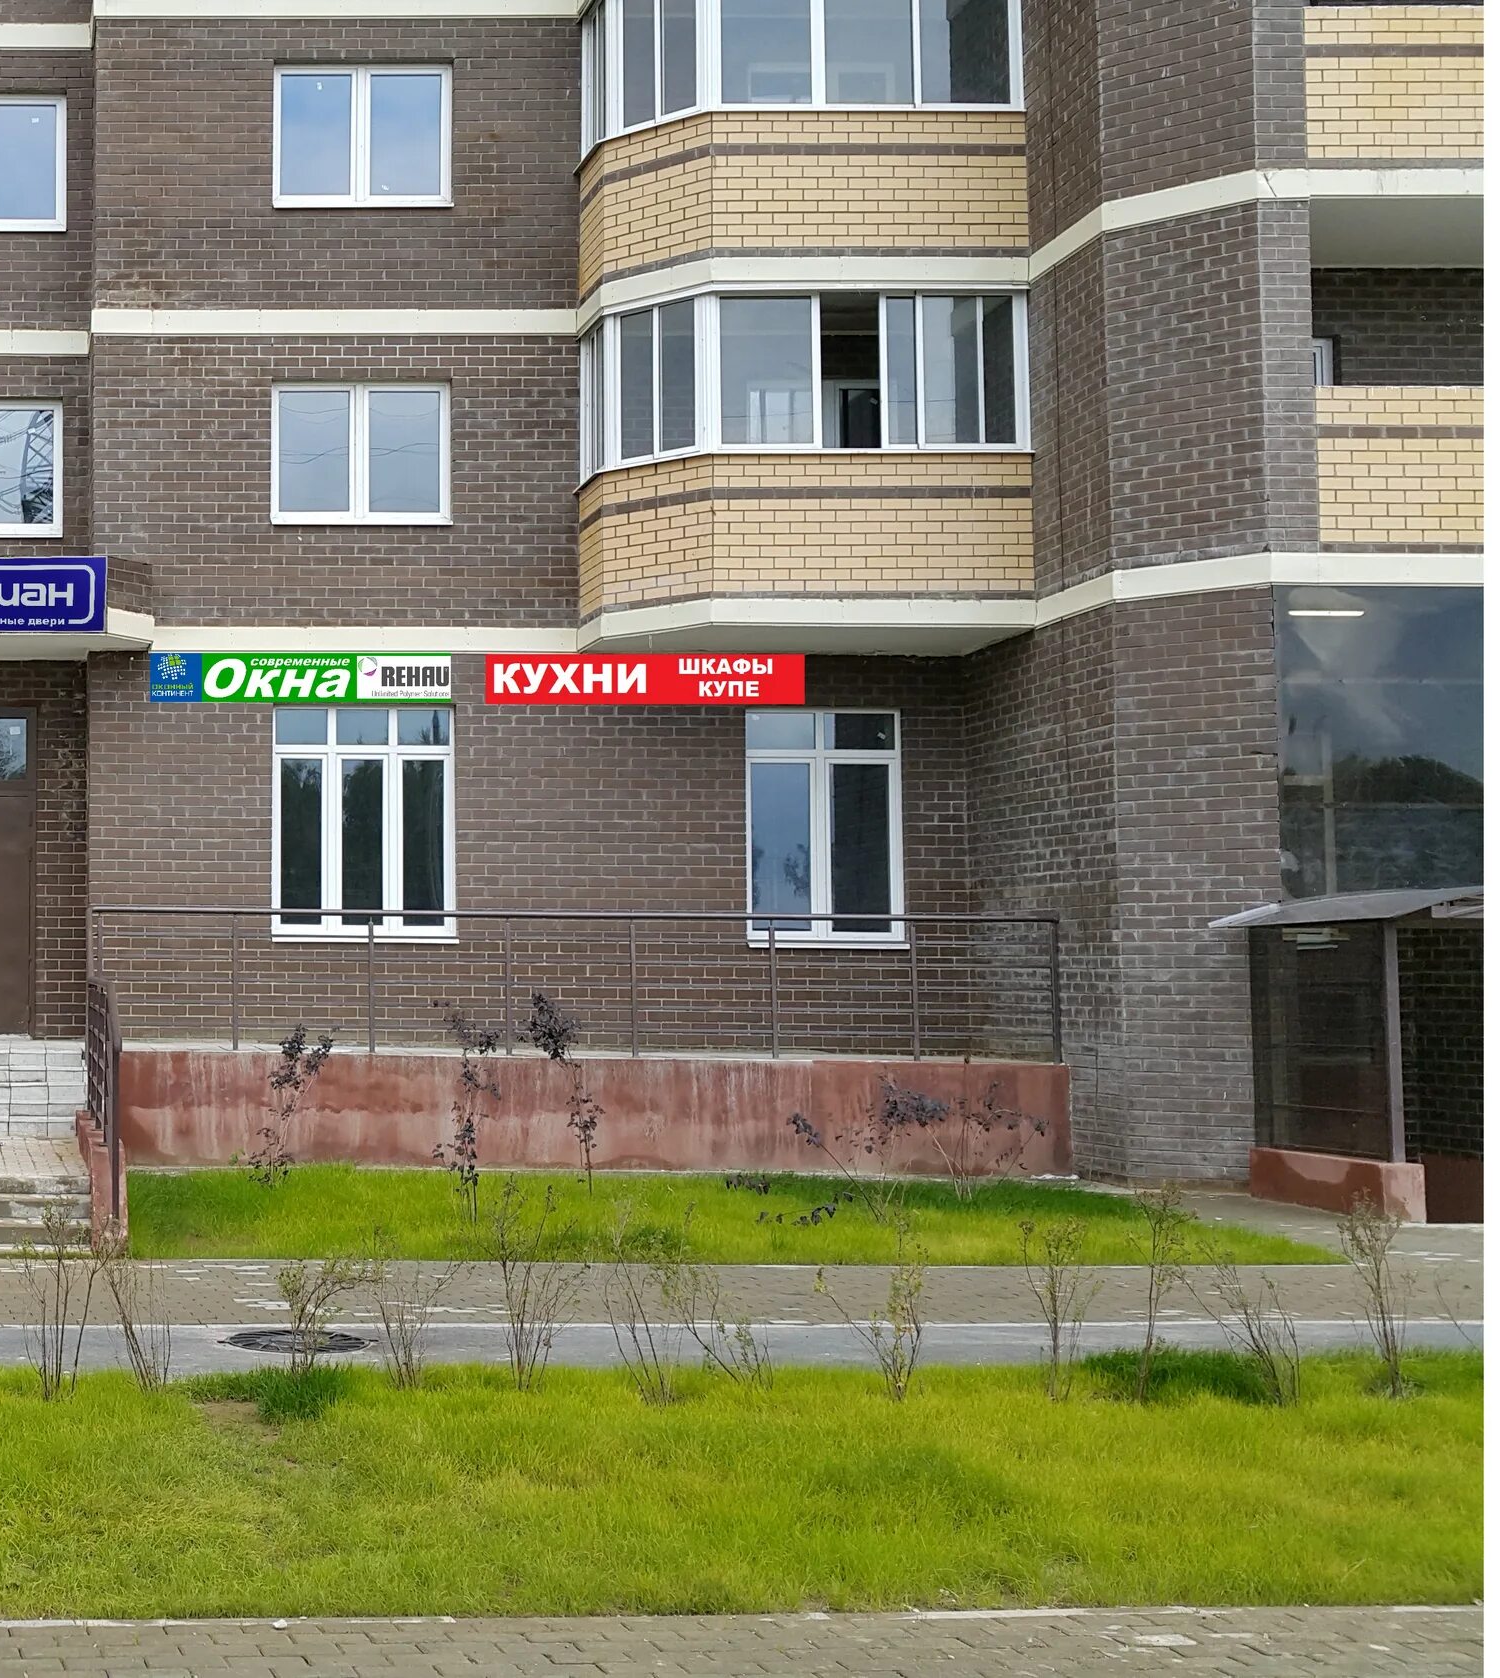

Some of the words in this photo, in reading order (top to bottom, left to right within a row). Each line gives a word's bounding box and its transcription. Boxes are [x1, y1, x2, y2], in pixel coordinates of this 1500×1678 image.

[27, 617, 66, 627] двери
[250, 657, 351, 667] современные
[678, 658, 773, 675] ШКАФЫ
[203, 658, 351, 698] Окна
[381, 666, 450, 687] REHAU
[493, 663, 647, 694] КУХНИ
[698, 681, 760, 697] КУПЕ
